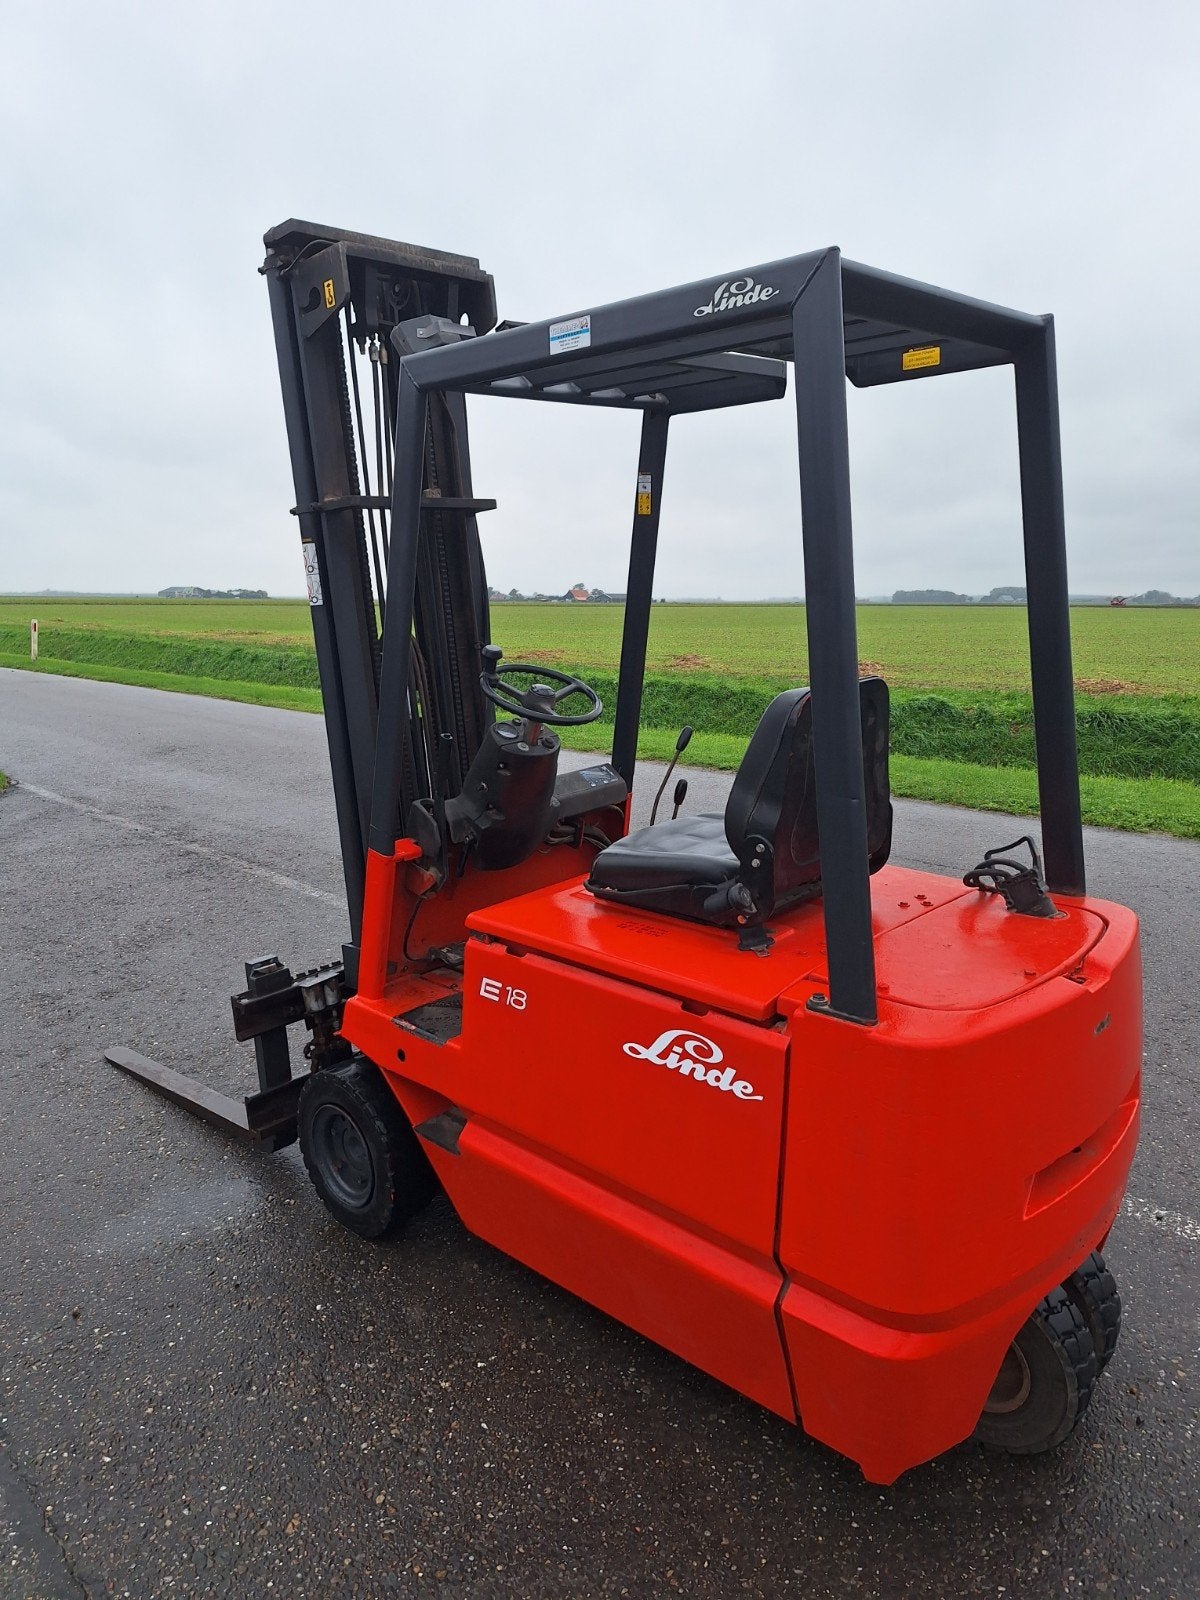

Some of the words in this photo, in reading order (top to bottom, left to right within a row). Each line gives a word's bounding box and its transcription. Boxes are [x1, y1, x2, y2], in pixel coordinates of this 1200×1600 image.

[693, 277, 780, 317] Linde
[479, 977, 503, 1002] E
[506, 986, 527, 1010] 18
[622, 1029, 764, 1101] Linde
